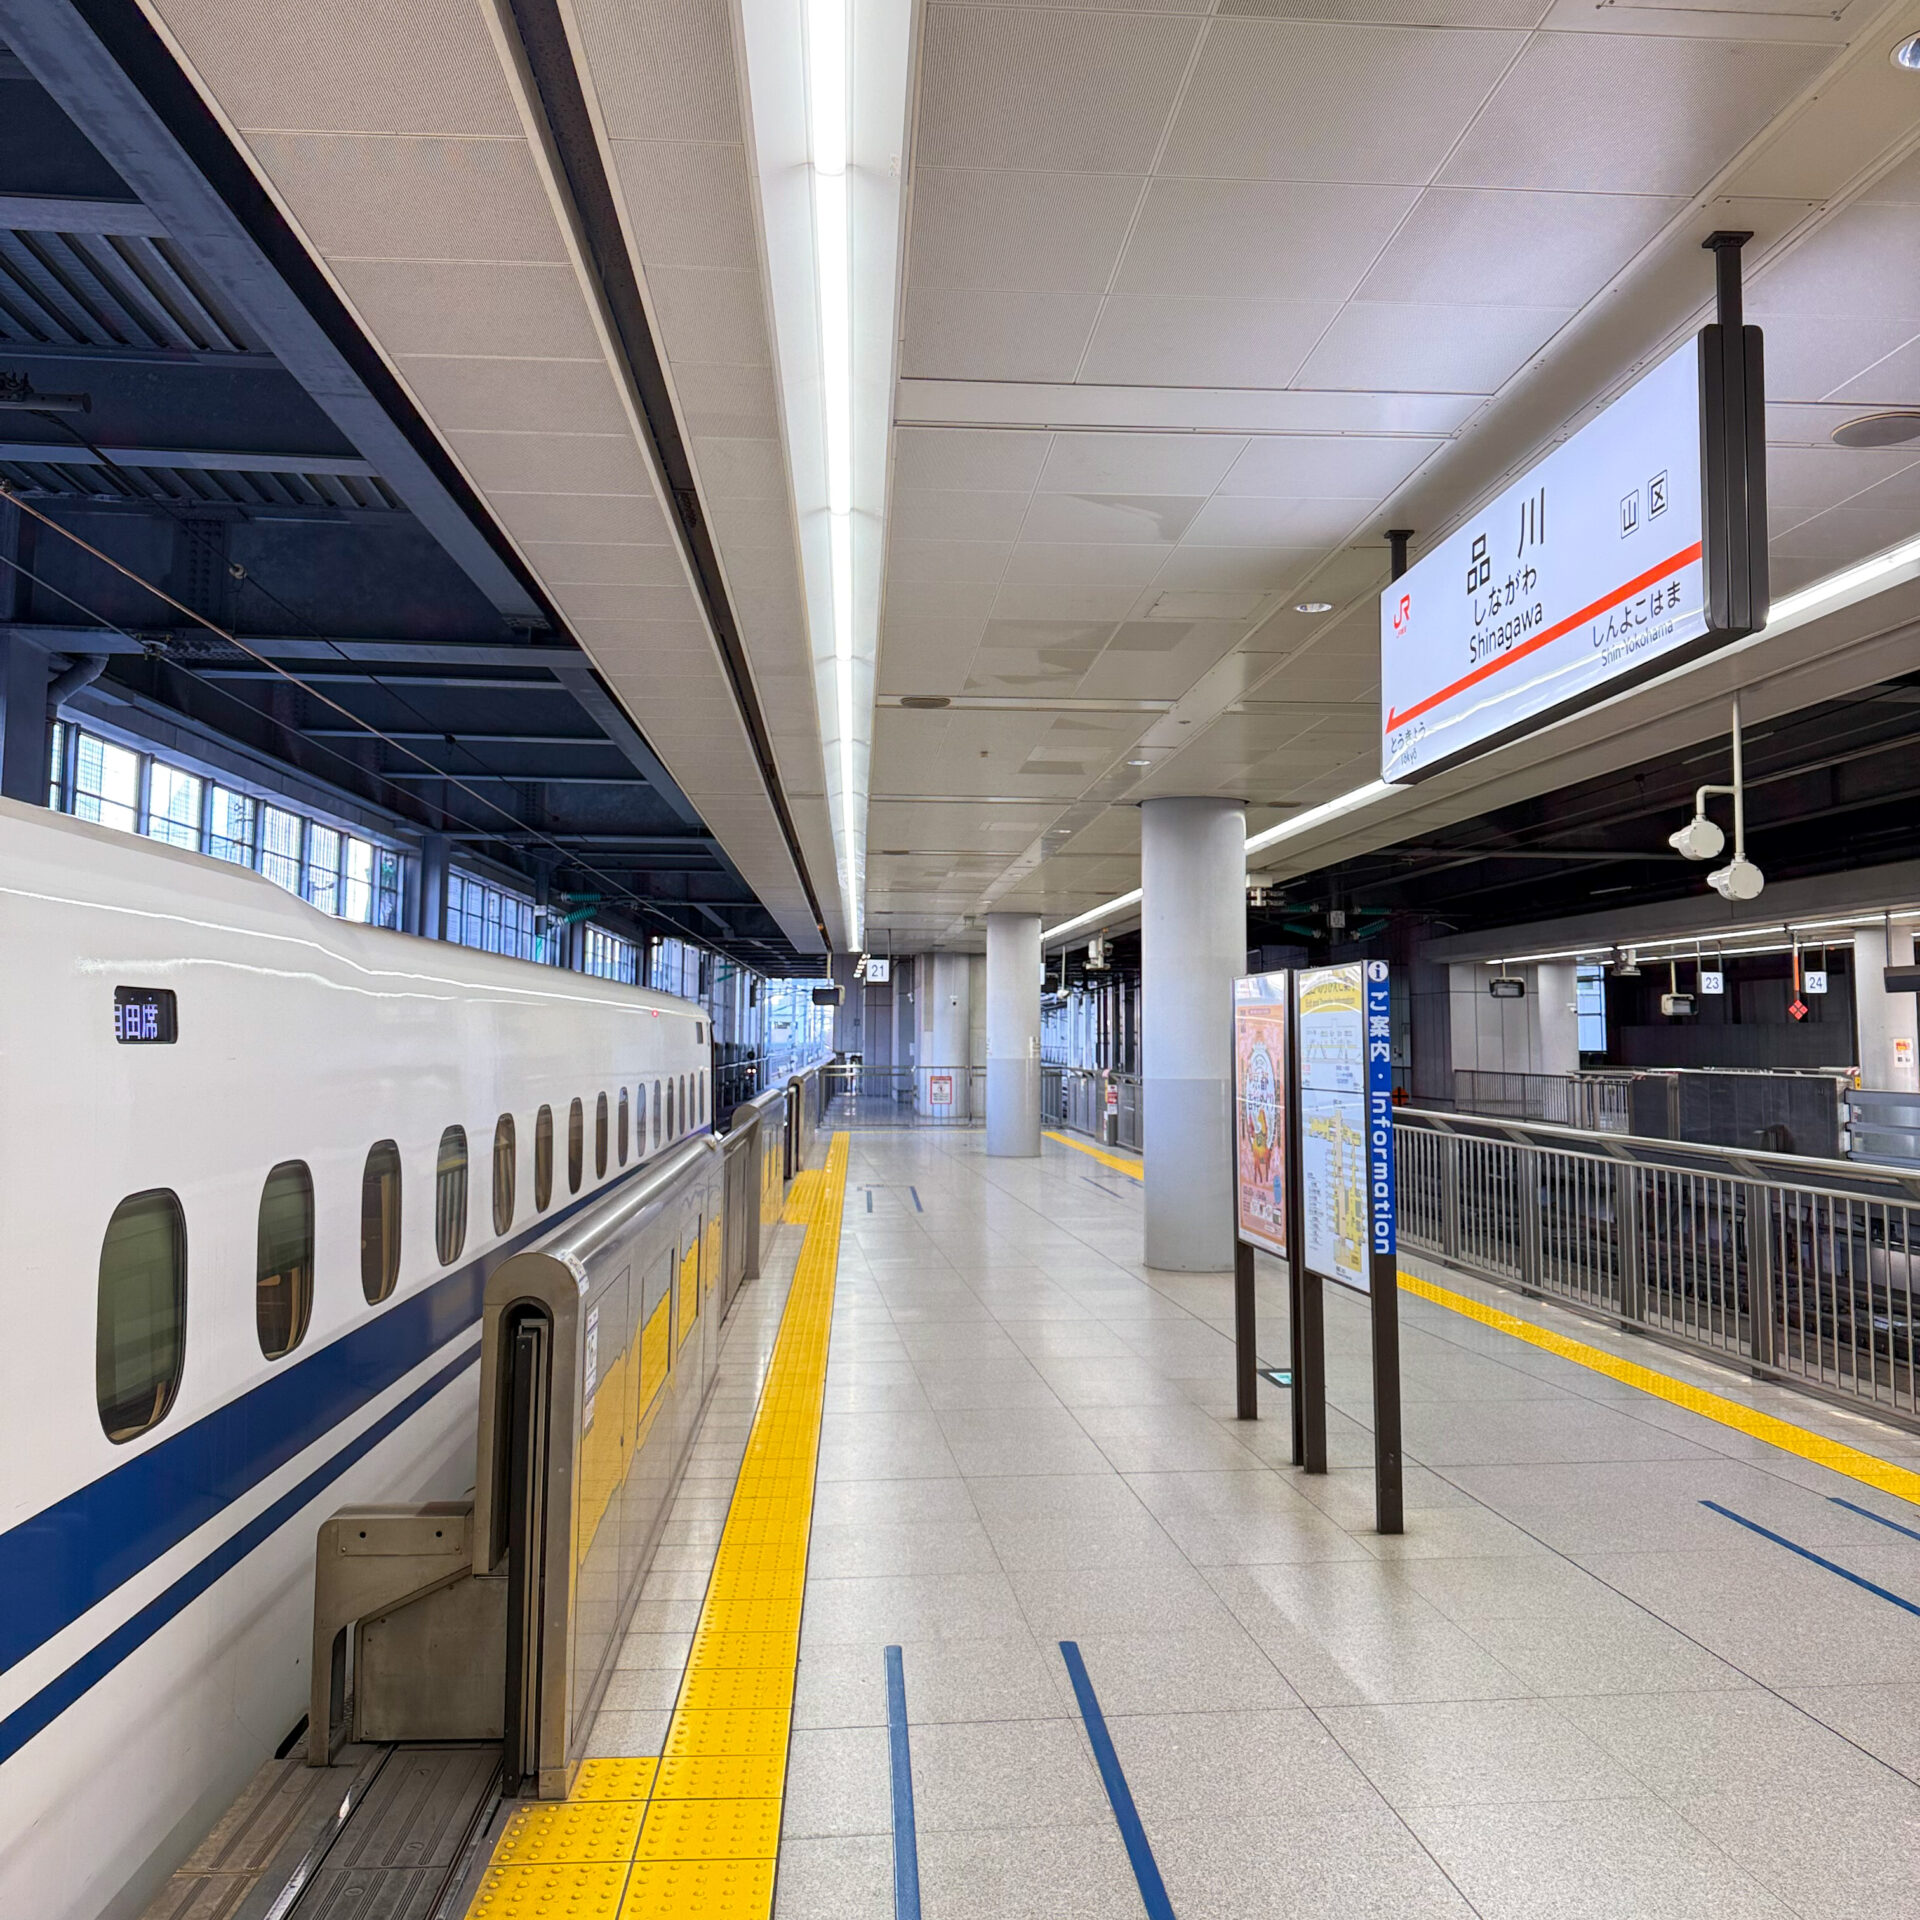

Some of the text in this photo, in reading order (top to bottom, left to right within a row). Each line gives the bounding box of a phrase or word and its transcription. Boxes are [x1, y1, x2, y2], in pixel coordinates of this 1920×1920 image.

[1467, 486, 1545, 596] 品川
[1393, 593, 1411, 629] JR
[1473, 563, 1537, 627] しながわ
[1592, 580, 1681, 648] しんよこはま
[1469, 601, 1543, 664] Shinagawa
[1601, 619, 1674, 667] Shin-Yokohama
[1391, 721, 1426, 754] とうきょう
[871, 964, 884, 977] 21
[1705, 976, 1720, 990] 23
[1808, 976, 1823, 990] 24
